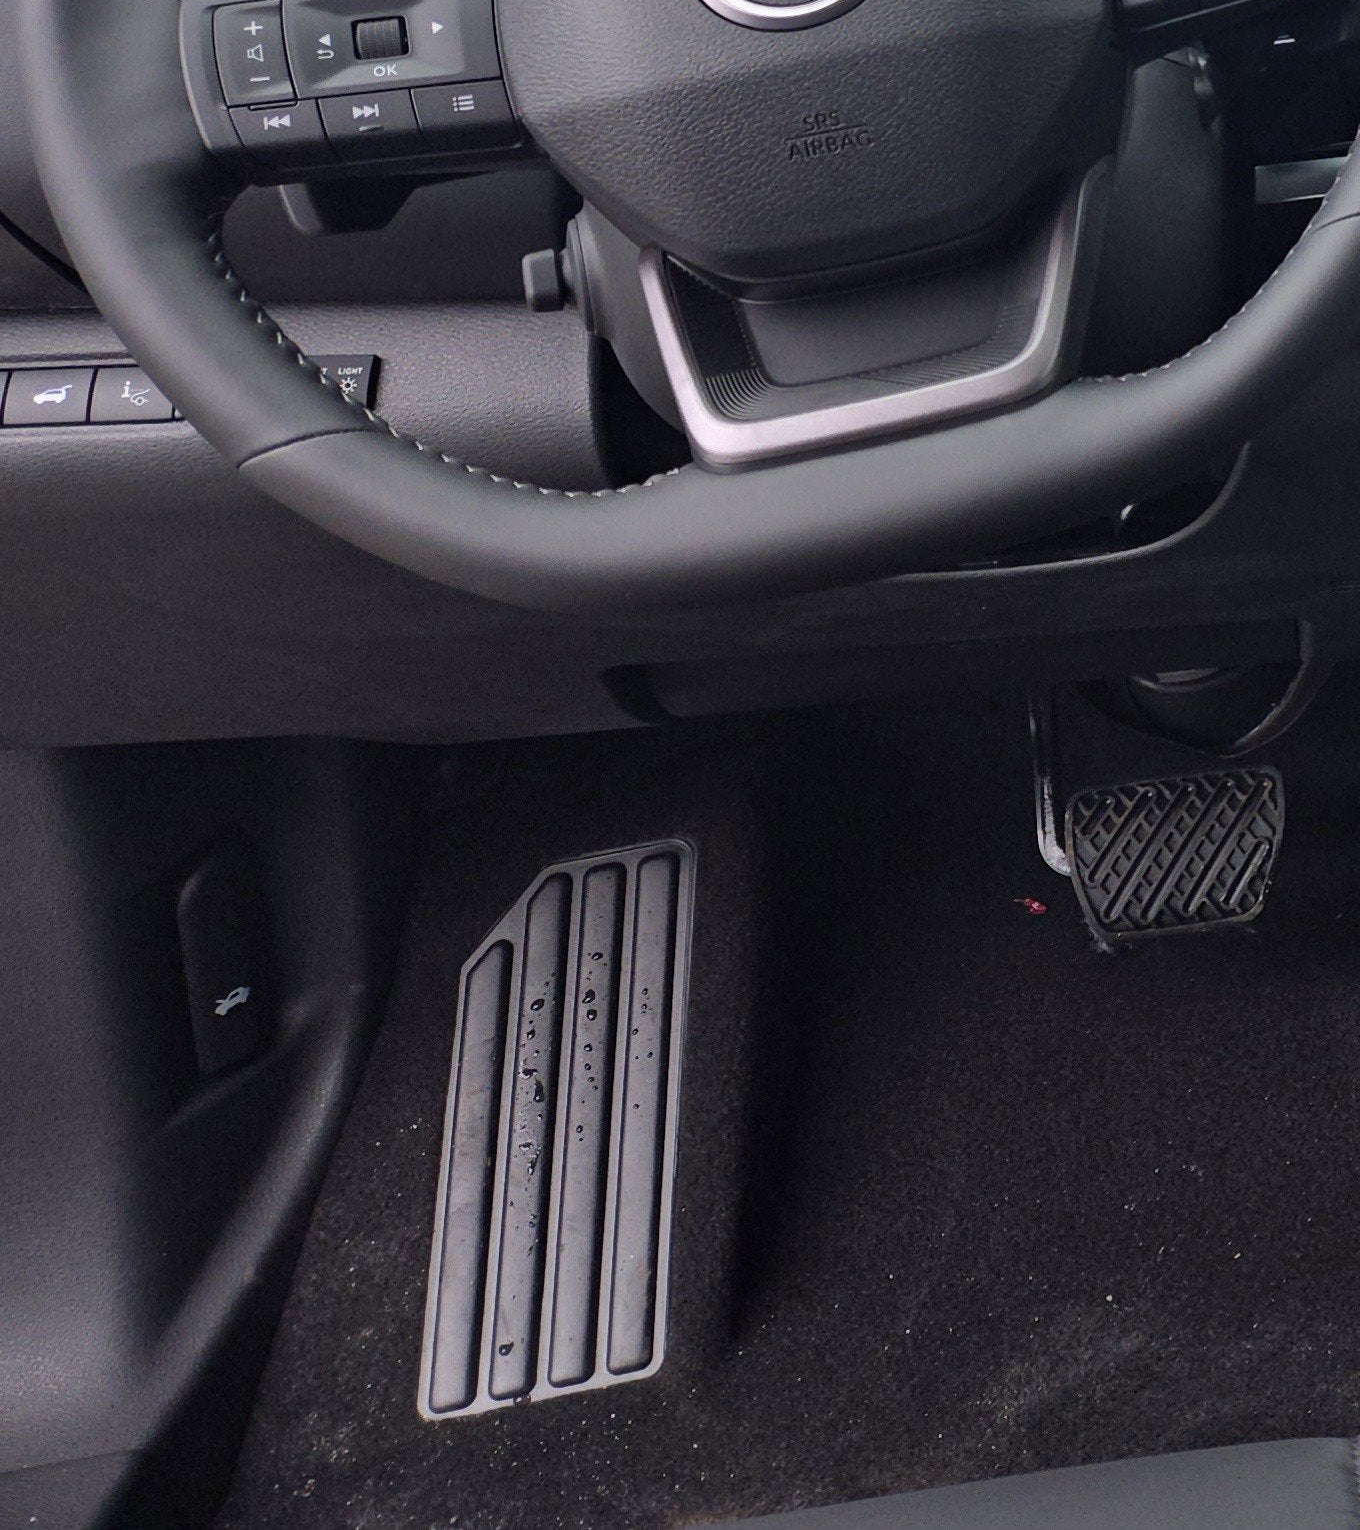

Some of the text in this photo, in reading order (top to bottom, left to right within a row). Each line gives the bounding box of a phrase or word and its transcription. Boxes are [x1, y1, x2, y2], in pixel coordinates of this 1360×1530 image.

[373, 64, 399, 77] OK
[788, 130, 872, 161] AIRBAG
[337, 367, 363, 376] LIGHT
